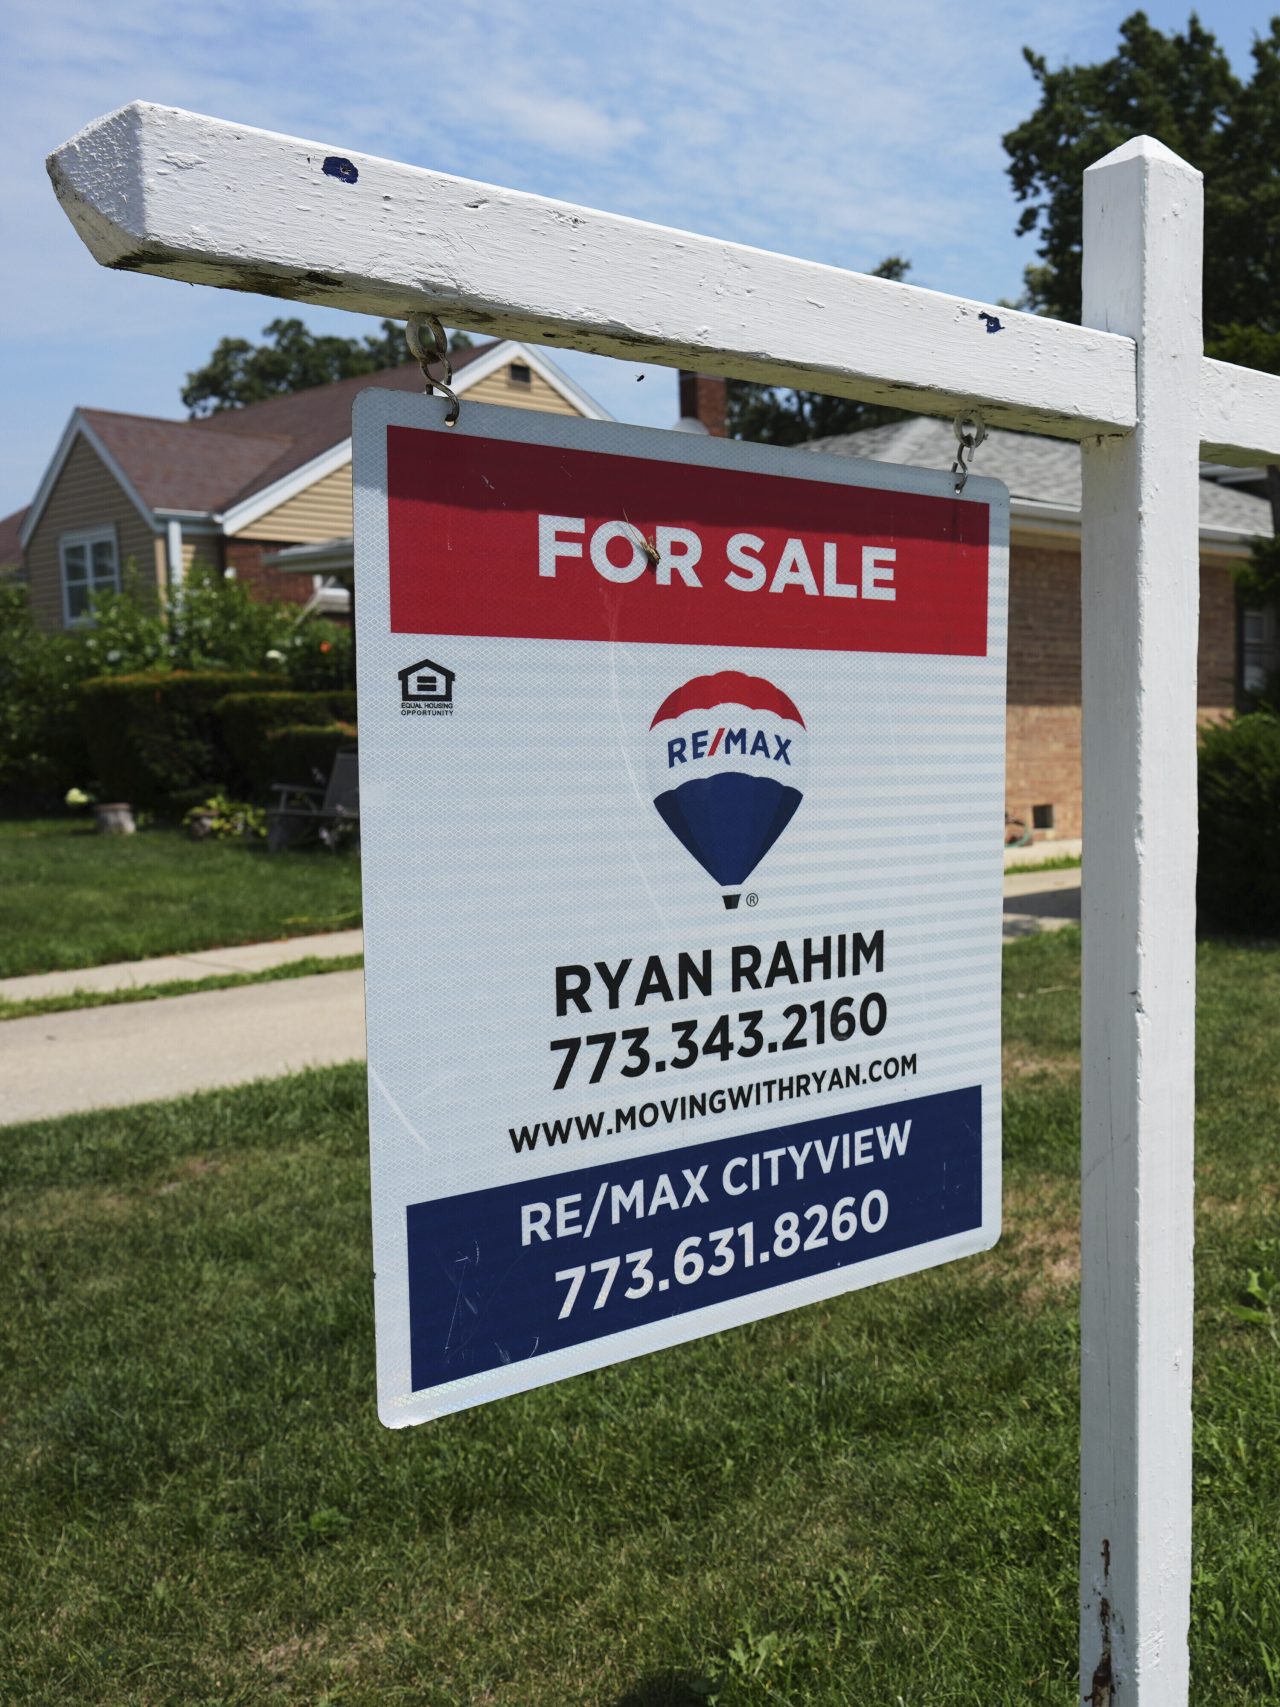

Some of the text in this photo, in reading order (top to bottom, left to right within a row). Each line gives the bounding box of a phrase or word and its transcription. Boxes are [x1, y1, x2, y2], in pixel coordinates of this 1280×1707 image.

[538, 513, 898, 601] FOR SALE
[667, 727, 793, 768] RE/MAX
[554, 929, 886, 1017] RYAN RAHIM
[549, 991, 888, 1091] 773.343.2160
[508, 1053, 919, 1154] WWW.MOVINGWITHRYAN.COM
[520, 1119, 913, 1246] RE/MAX CITYVIEW
[555, 1189, 890, 1321] 773.631.8260
